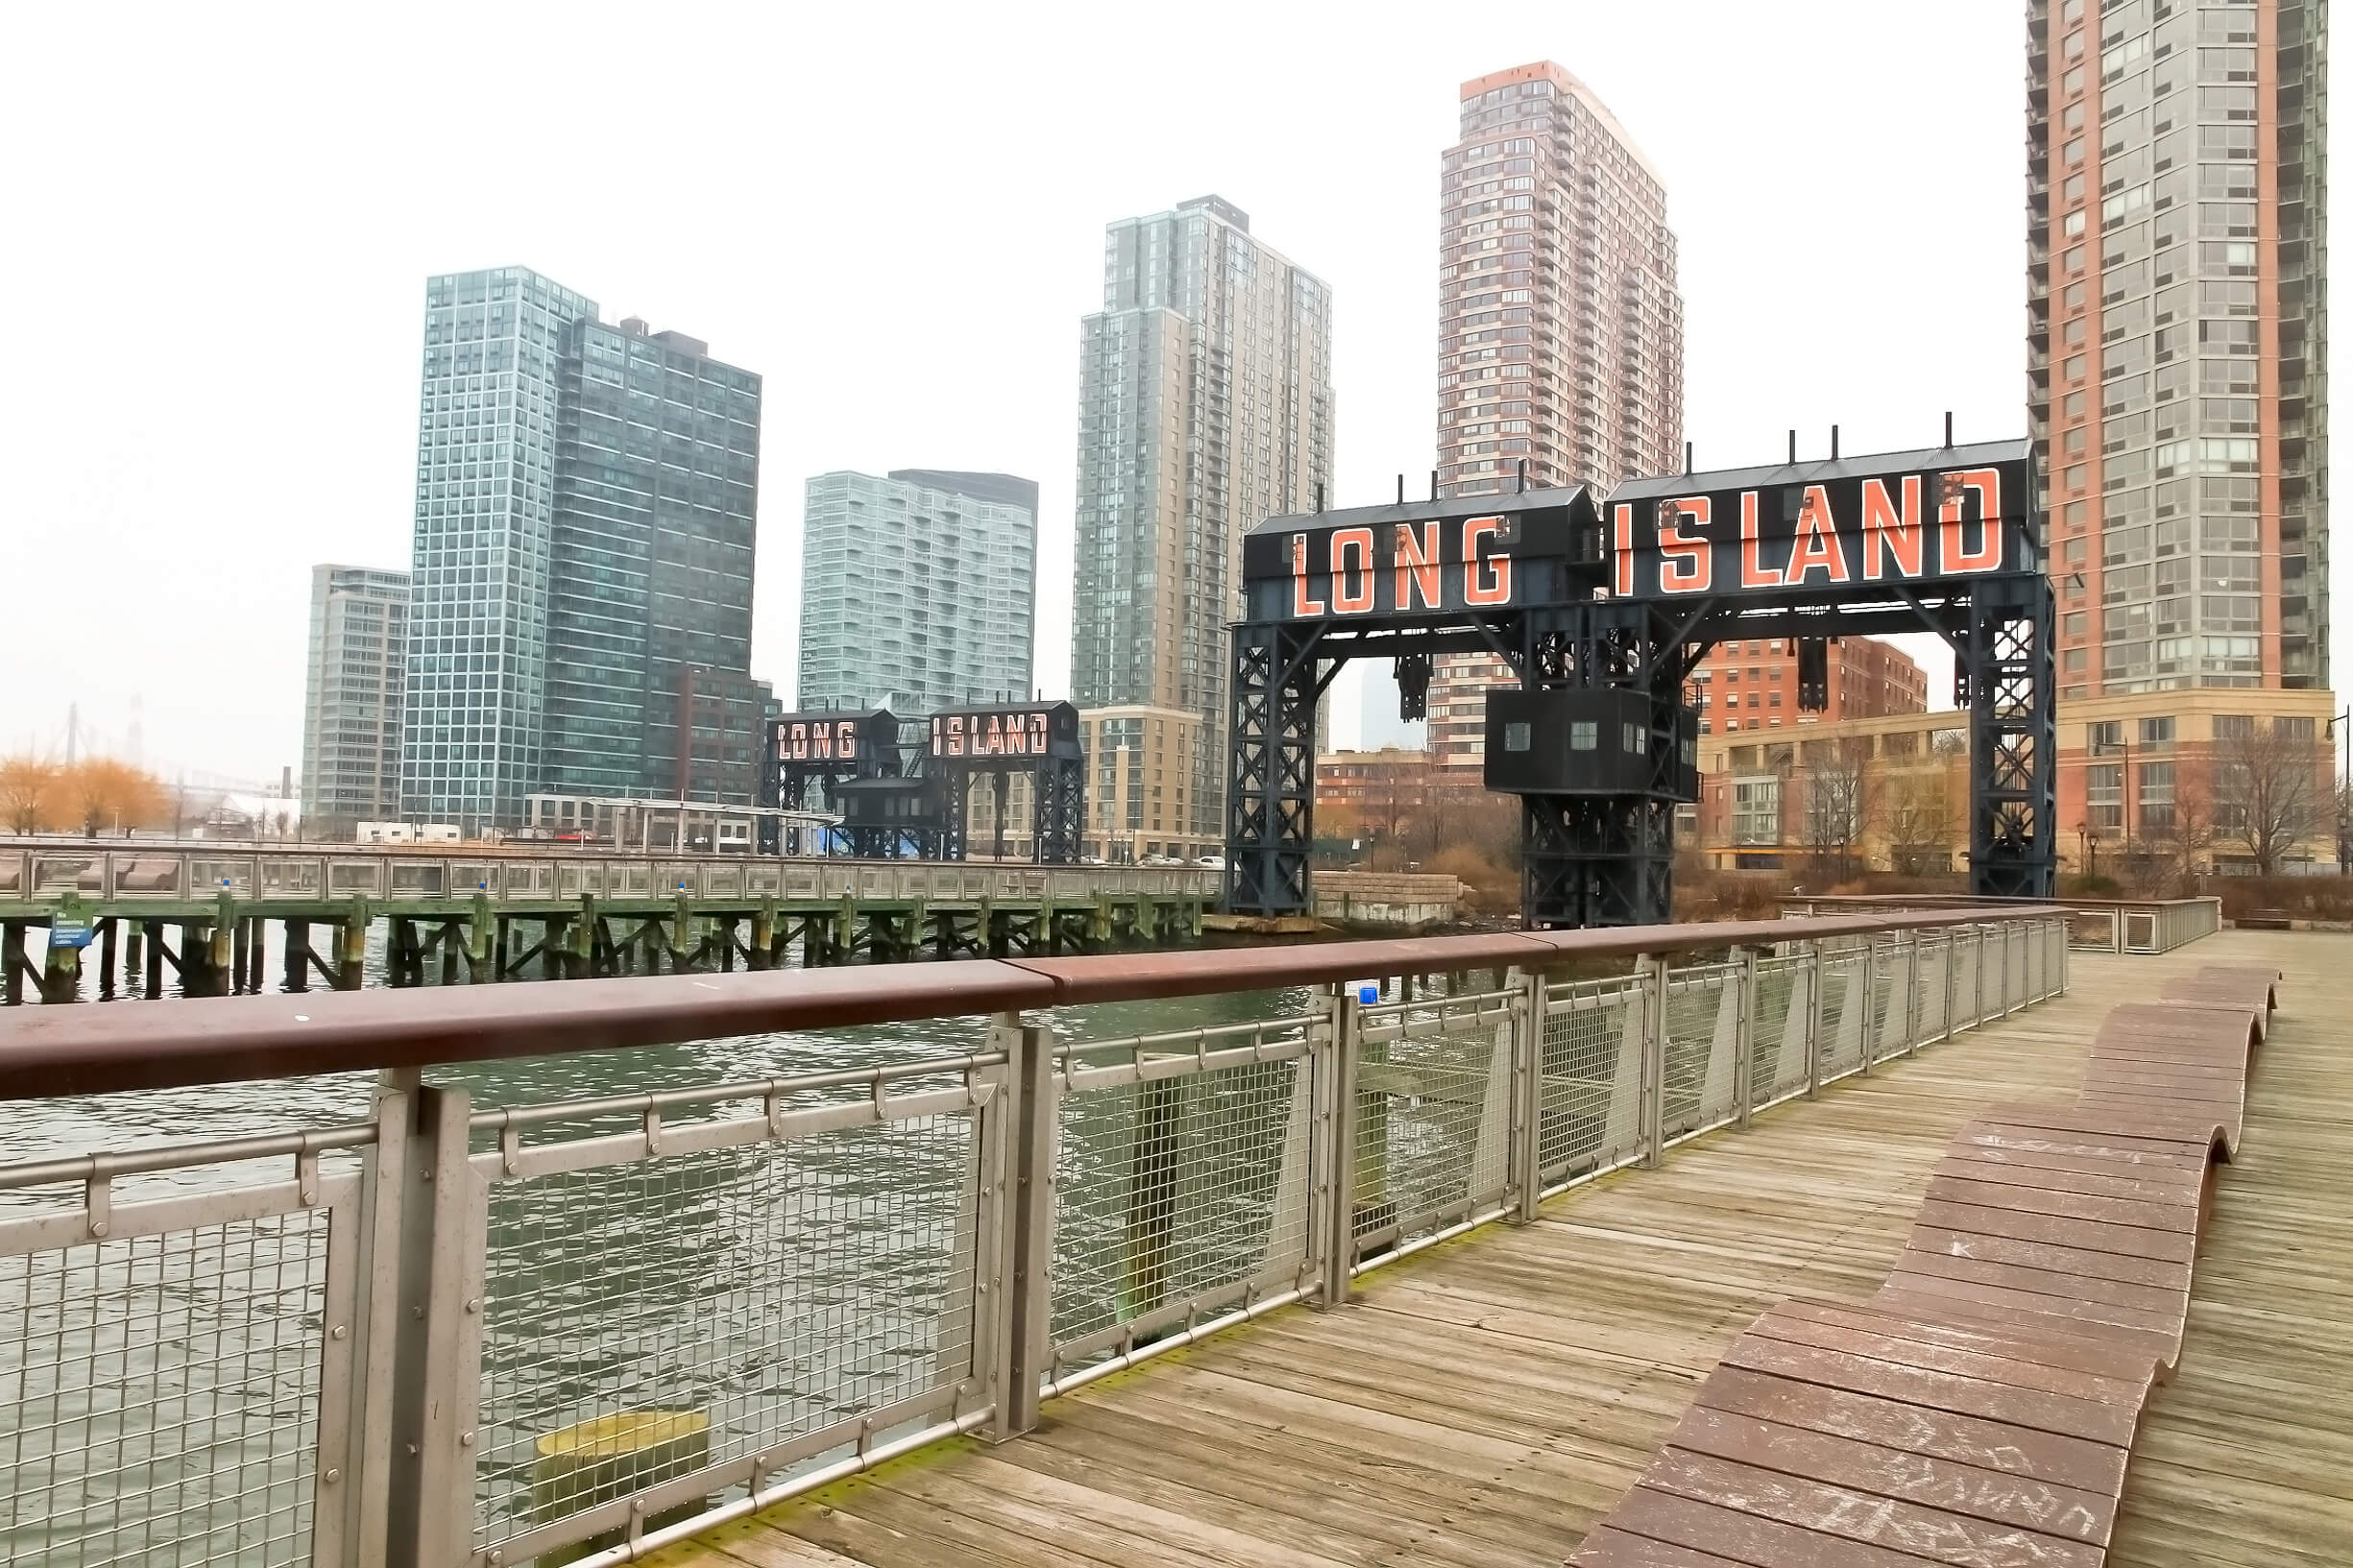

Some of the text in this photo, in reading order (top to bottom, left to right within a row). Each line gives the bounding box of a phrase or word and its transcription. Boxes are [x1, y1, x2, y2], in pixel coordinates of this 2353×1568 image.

[1293, 468, 2001, 616] LONG ISLAND
[778, 712, 1048, 760] LONG ISLAND
